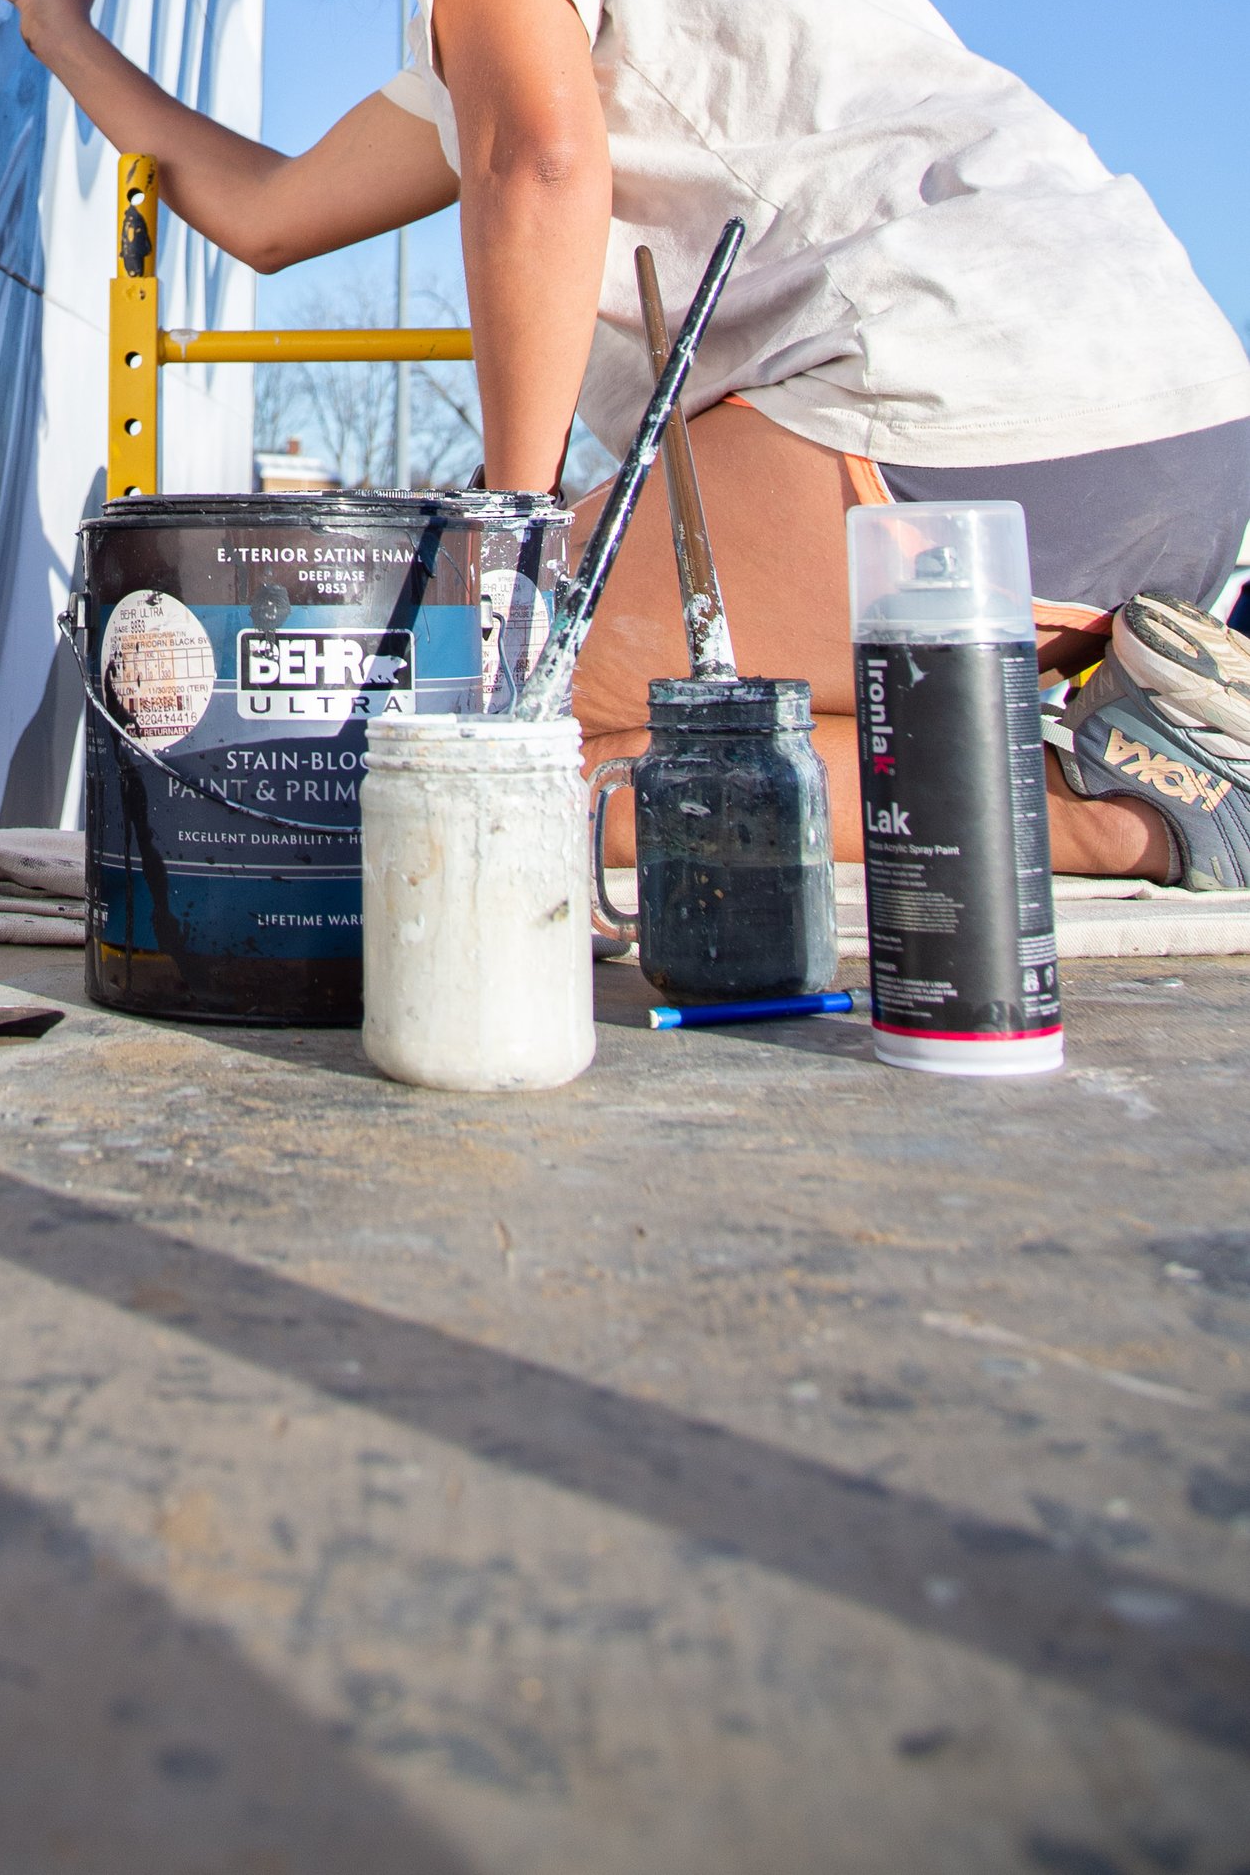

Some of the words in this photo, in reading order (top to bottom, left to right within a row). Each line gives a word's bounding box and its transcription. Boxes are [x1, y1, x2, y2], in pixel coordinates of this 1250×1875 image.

[217, 547, 308, 563] ETERIOR
[313, 548, 366, 563] SATIN
[372, 549, 423, 563] ENAM
[299, 570, 330, 582] DEEP
[335, 570, 365, 582] BASE
[317, 583, 347, 594] 9853
[120, 608, 137, 620] BEHR
[139, 606, 164, 618] ULTRA
[170, 637, 197, 646] BLACK
[249, 639, 365, 684] BEHR
[251, 696, 402, 713] ULTRA
[867, 659, 895, 775] Ironlak
[1104, 727, 1232, 813] HOKA
[168, 777, 248, 801] PAINT
[256, 780, 276, 802] &
[286, 781, 360, 802] PRIM
[866, 801, 912, 836] Lak
[178, 831, 247, 844] EXCELLENT
[251, 834, 333, 845] DURABILITY
[884, 842, 907, 854] Acrylic
[909, 844, 934, 856] Spray
[935, 845, 960, 855] Paint
[258, 914, 323, 926] LIFETIME
